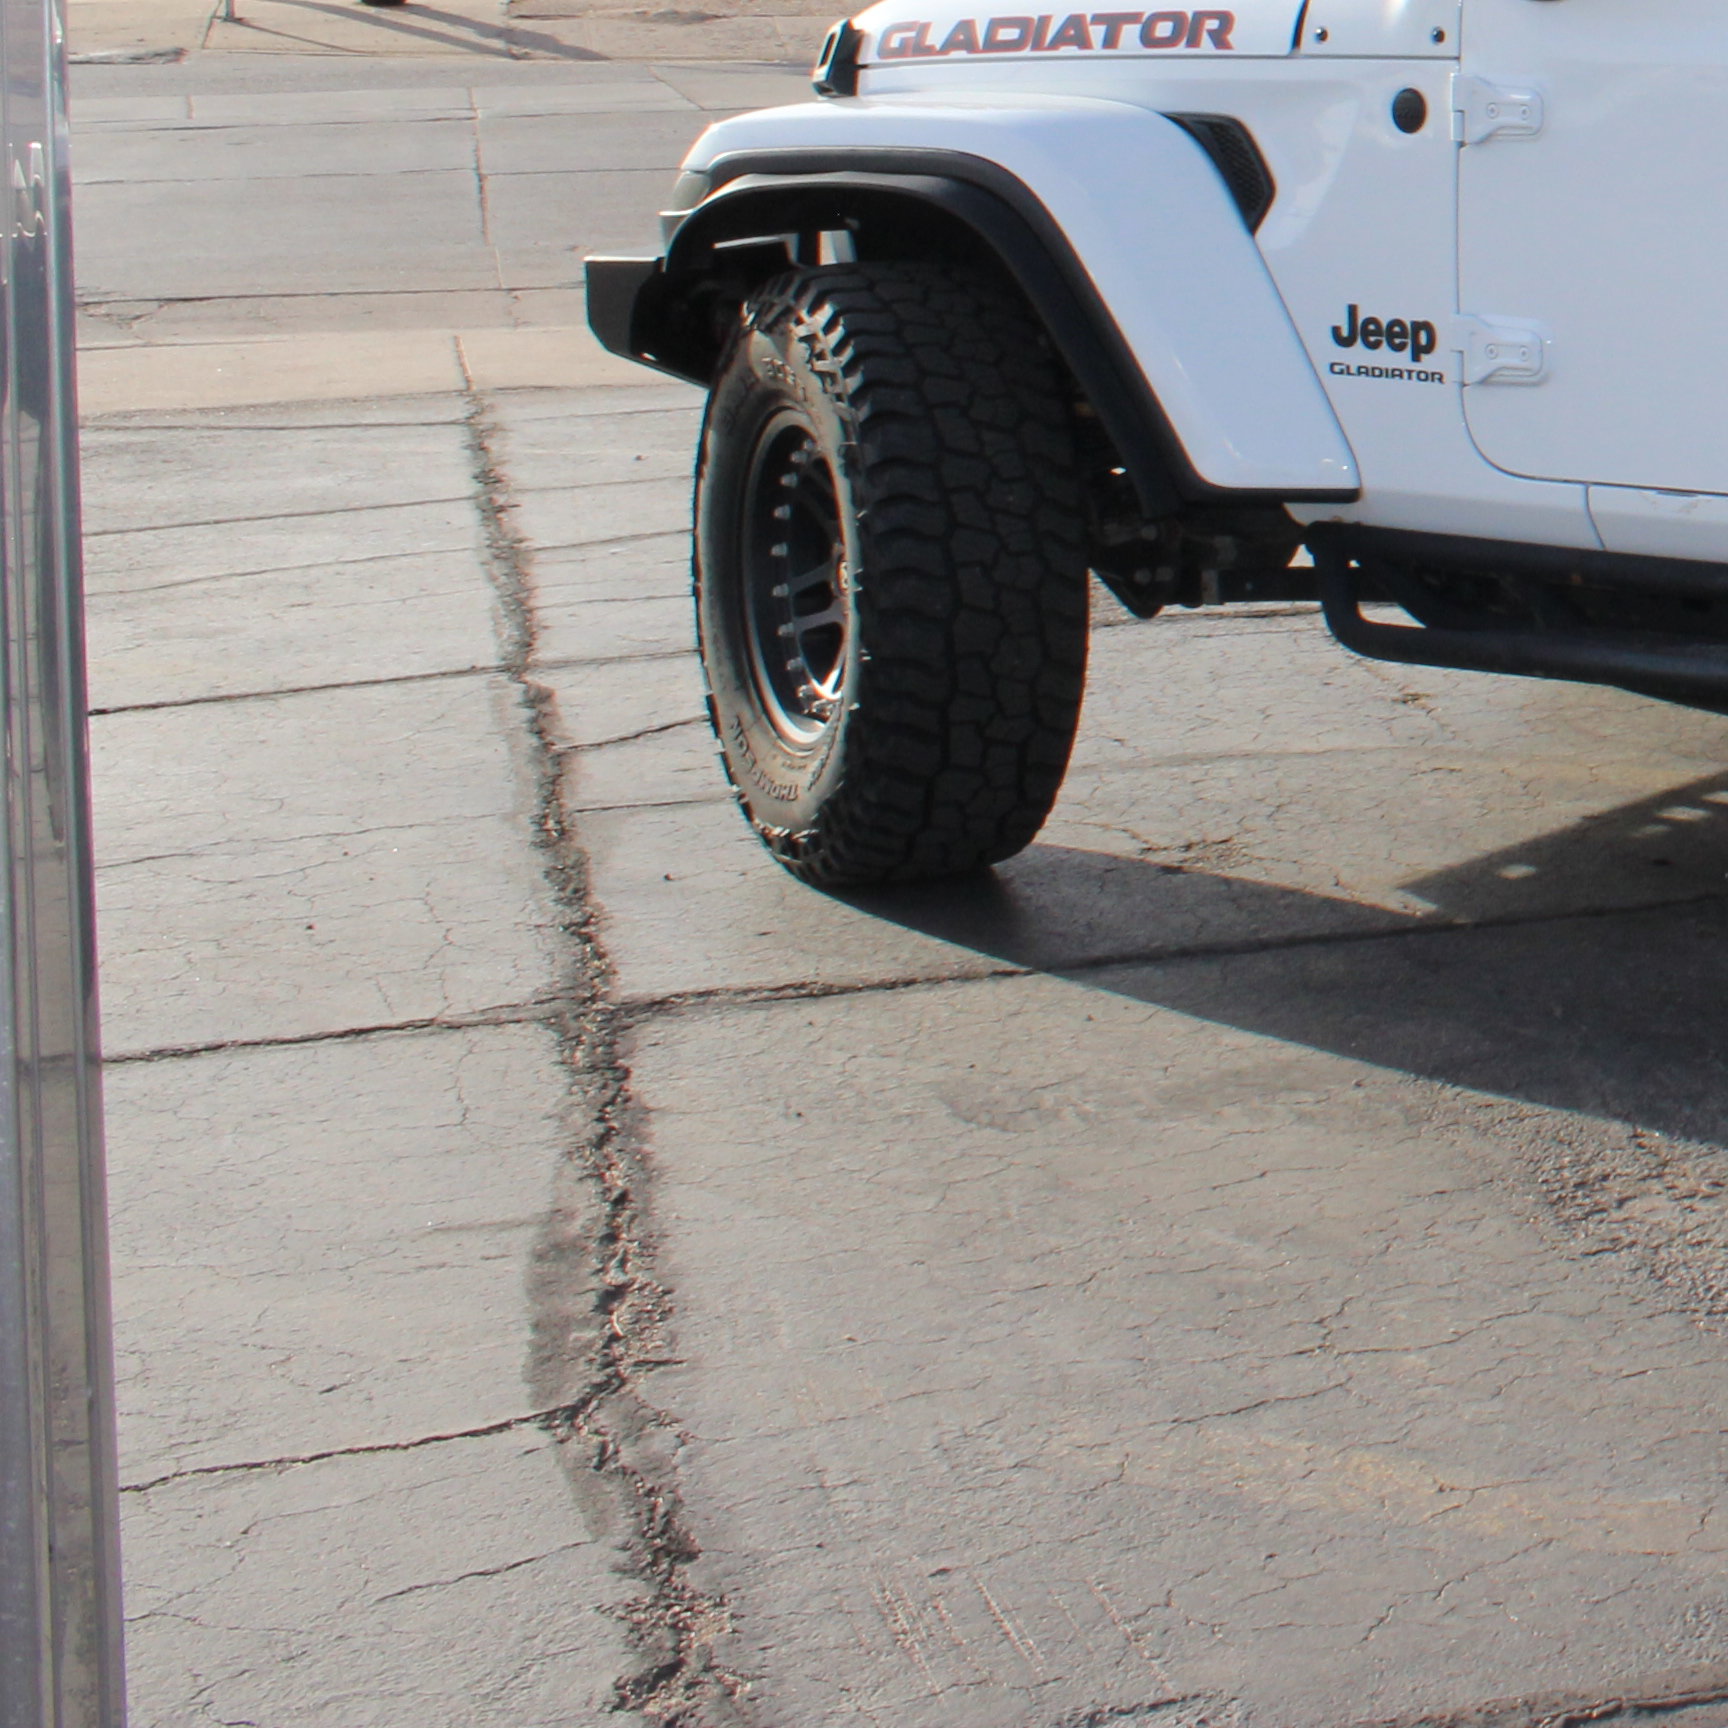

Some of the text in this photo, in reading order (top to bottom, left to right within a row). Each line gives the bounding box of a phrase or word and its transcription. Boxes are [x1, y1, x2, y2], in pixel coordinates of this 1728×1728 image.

[876, 9, 1236, 60] GLADIATOR
[1330, 303, 1438, 363] Jeep
[1329, 361, 1446, 384] GLADIATOR
